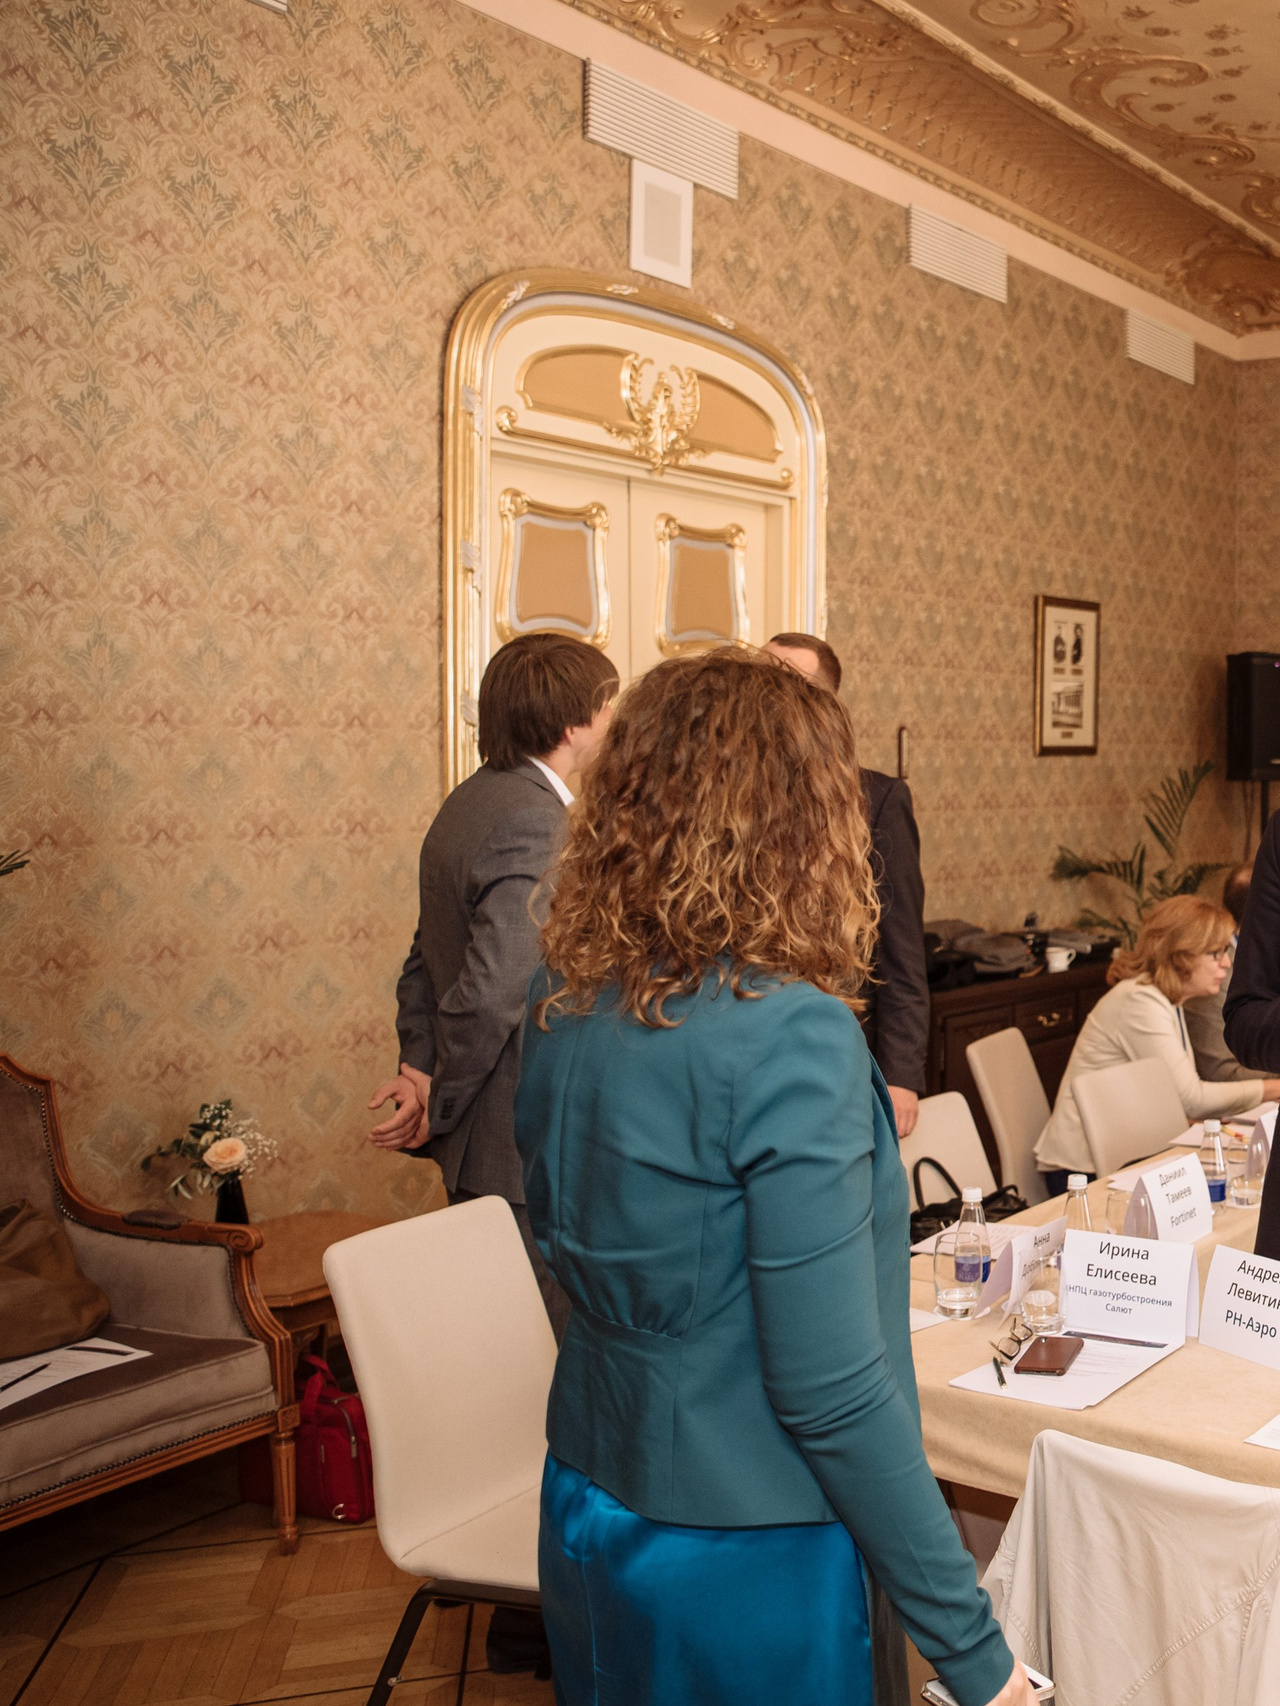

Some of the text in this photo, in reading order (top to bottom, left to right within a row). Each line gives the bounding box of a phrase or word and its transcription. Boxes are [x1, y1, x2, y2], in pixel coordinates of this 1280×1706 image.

[1159, 1167, 1187, 1188] Даниил
[1170, 1207, 1197, 1228] Fortinet
[1034, 1233, 1050, 1248] Анна
[1099, 1241, 1150, 1260] Ирина
[1086, 1263, 1157, 1286] Елисеева
[1089, 1288, 1172, 1307] газотурбостроения
[1105, 1303, 1133, 1314] Салют
[1225, 1309, 1277, 1338] РН-Аэро
